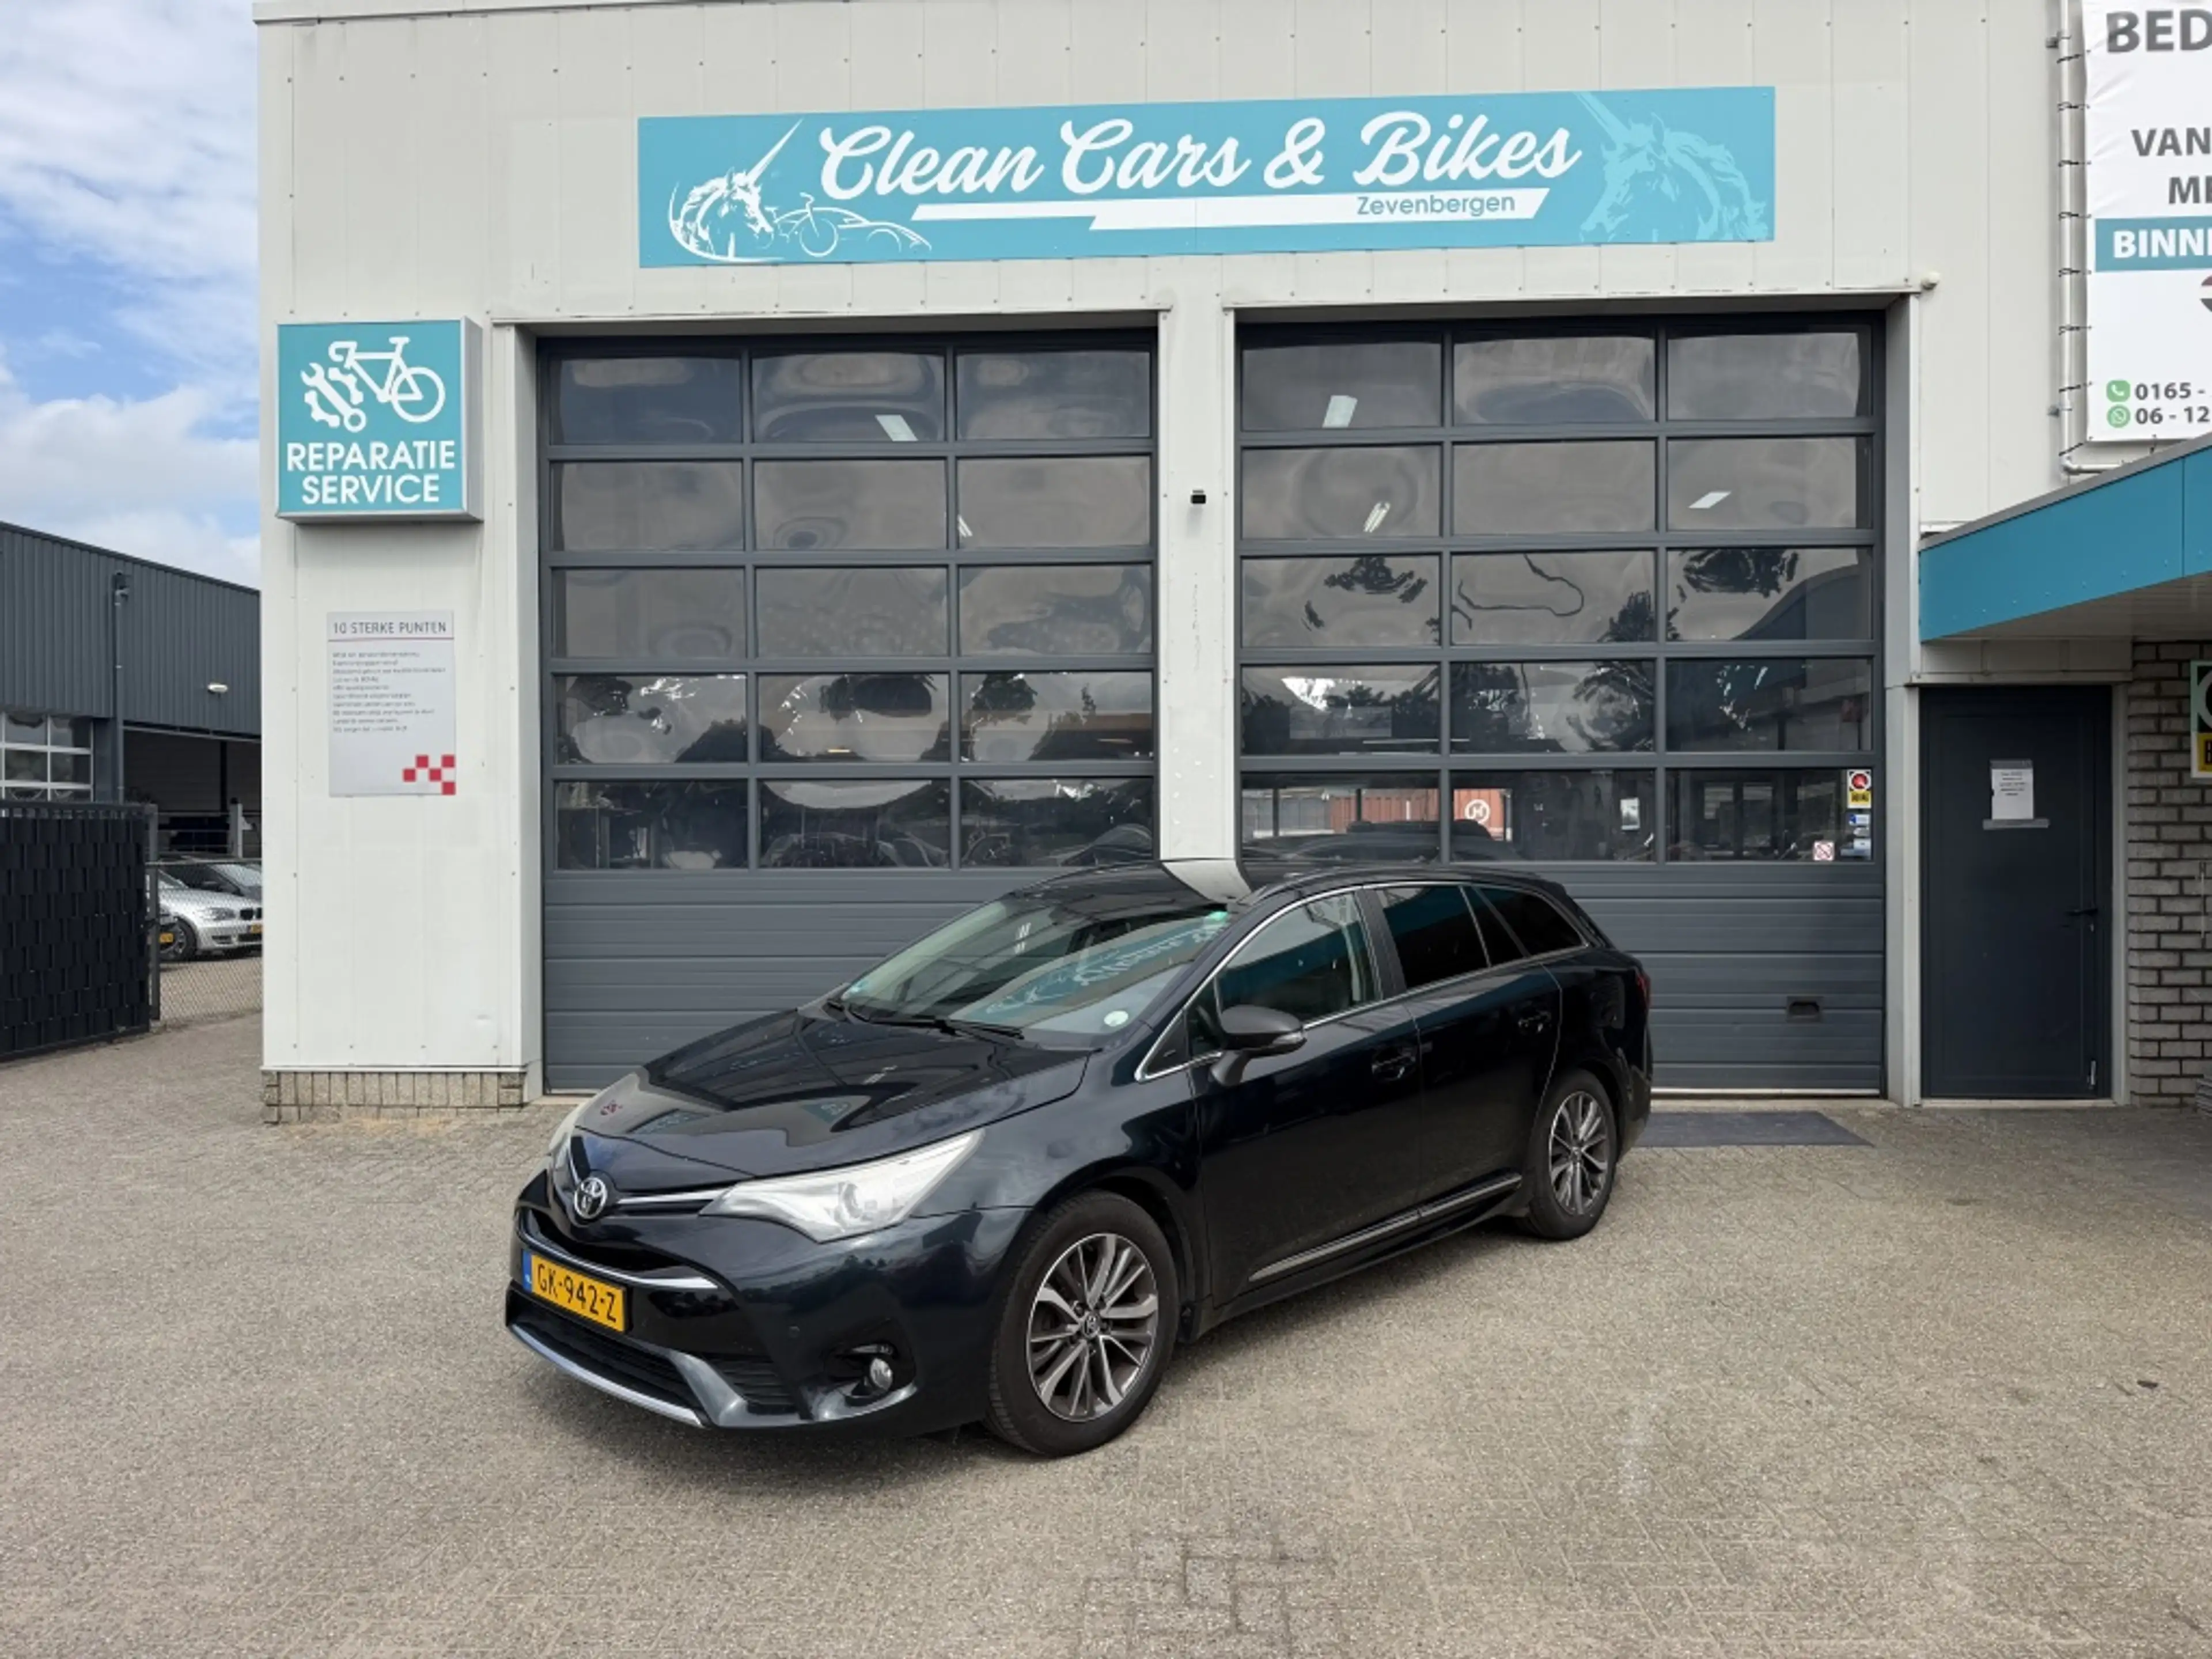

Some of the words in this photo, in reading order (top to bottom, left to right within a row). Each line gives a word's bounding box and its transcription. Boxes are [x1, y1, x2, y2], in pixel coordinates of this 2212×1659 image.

[2107, 9, 2212, 53] BED
[819, 126, 1044, 200] Clean
[1060, 118, 1252, 195] Cars
[1263, 117, 1325, 189] &
[1353, 111, 1582, 187] Bikes
[2131, 127, 2211, 157] VAN
[1357, 195, 1516, 217] Zevenbergen
[2113, 228, 2212, 259] BINN
[2135, 382, 2192, 400] 0165
[2135, 407, 2164, 425] 06
[2183, 406, 2210, 423] 12
[286, 440, 455, 471] REPARATIE
[302, 474, 440, 505] SERVICE
[334, 622, 347, 634] 10
[351, 621, 395, 634] STERKE
[399, 620, 447, 634] PUNTEN
[536, 1263, 618, 1323] GK-942-Z
